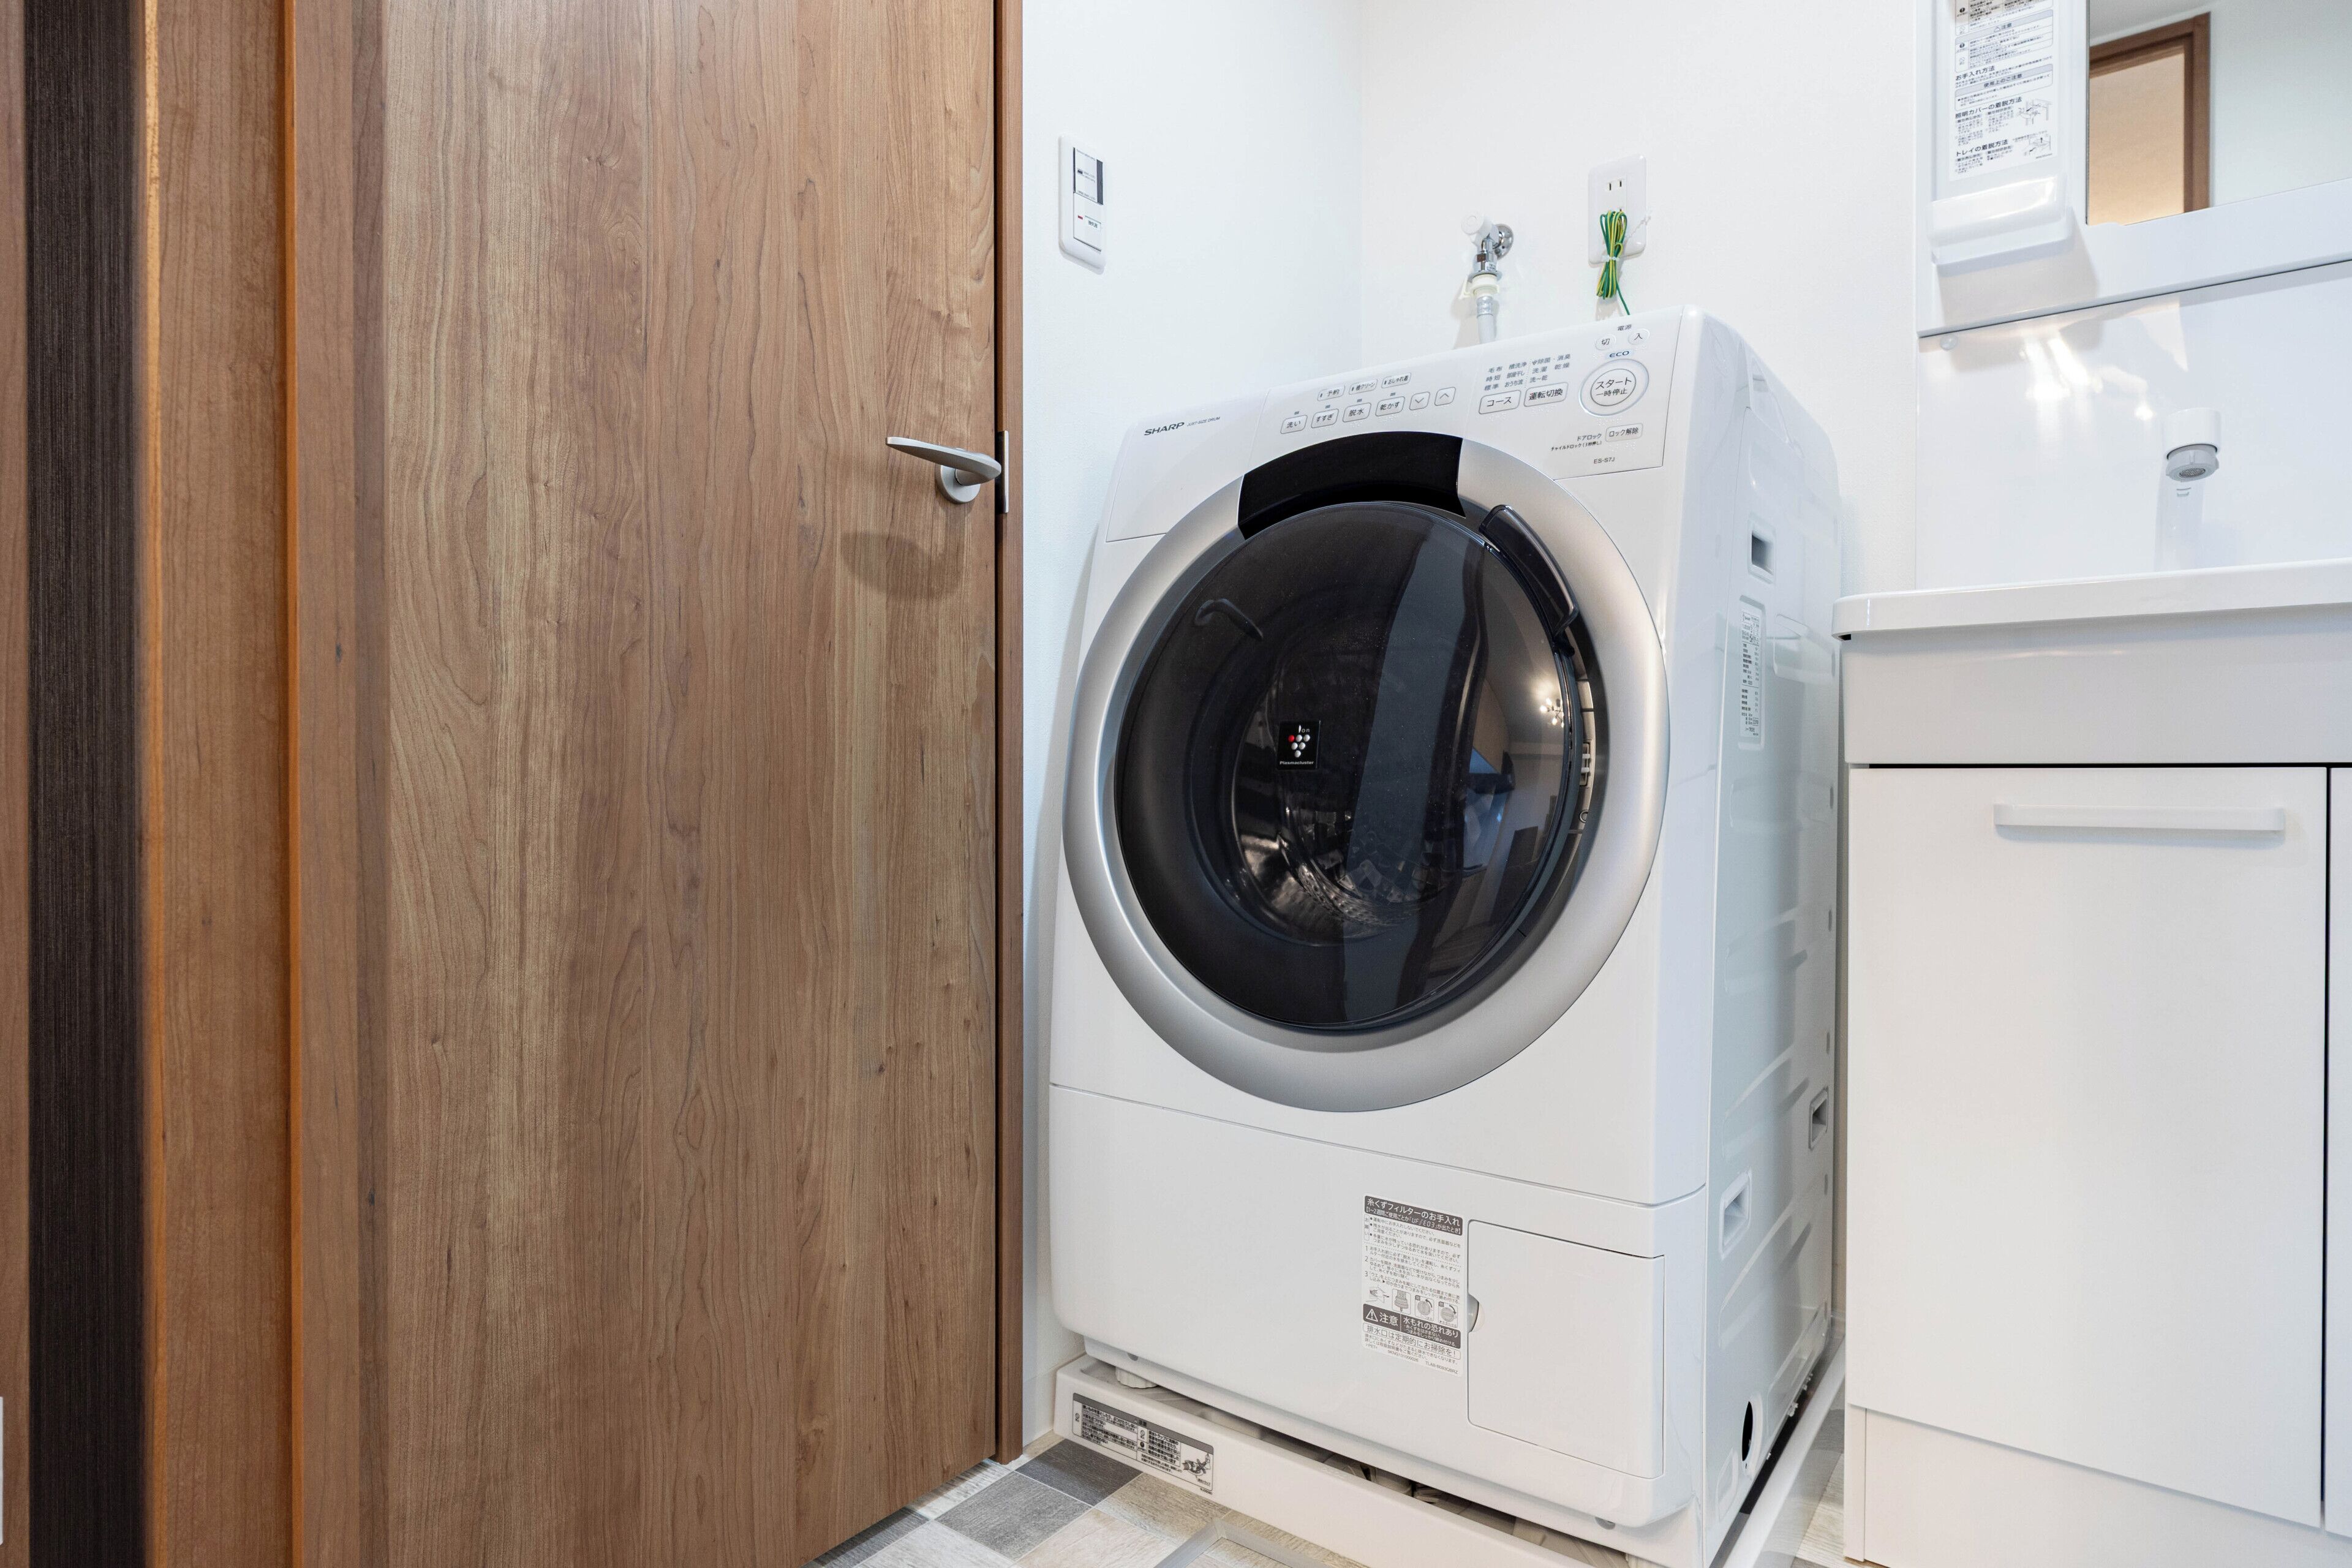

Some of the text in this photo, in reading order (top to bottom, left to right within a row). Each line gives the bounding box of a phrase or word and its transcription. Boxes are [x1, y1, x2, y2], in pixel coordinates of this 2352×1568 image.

[1956, 66, 1994, 80] お手入れ方法
[1984, 74, 2022, 88] 使用上のご注意
[1956, 97, 2022, 118] 照明カバーの着脱方法
[1956, 140, 2008, 156] トレイの着脱方法
[1388, 375, 1409, 385] おしゃれ着
[1596, 377, 1632, 390] スタート
[1528, 388, 1563, 401] 運転切換
[1596, 388, 1628, 396] 一時停止
[1380, 401, 1400, 411] 乾かす
[1487, 397, 1512, 407] コース
[1316, 413, 1334, 422] すすぎ
[1348, 408, 1364, 417] 脱水
[1144, 422, 1185, 435] SHARP
[1609, 427, 1639, 437] ロック解除
[1577, 433, 1602, 442] ドアロック
[1367, 1197, 1460, 1226] 糸くずフィルターのお手入れ
[1379, 1312, 1398, 1326] 注意
[1403, 1317, 1458, 1338] 水もれの恐れあり
